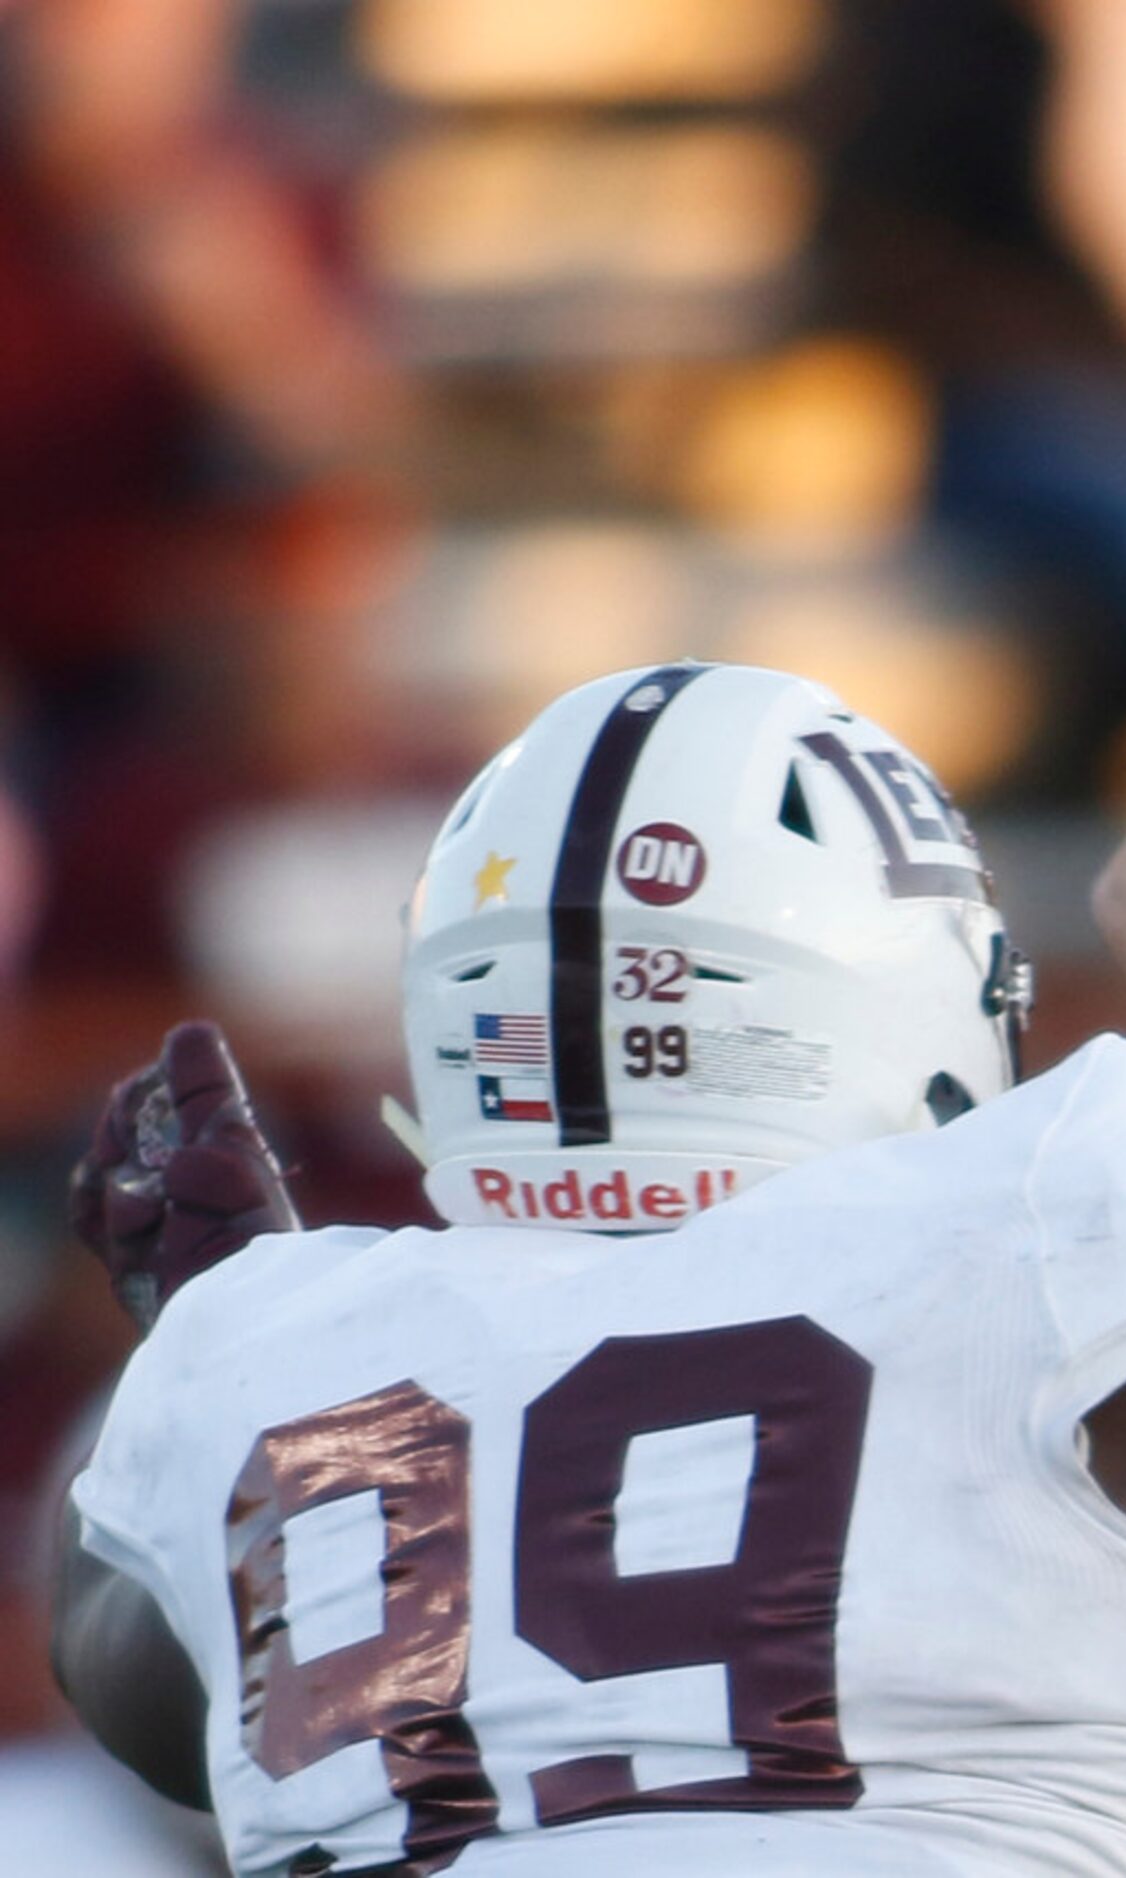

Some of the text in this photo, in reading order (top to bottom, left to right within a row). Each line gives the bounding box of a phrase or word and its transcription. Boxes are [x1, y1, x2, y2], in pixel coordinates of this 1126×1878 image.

[623, 834, 699, 888] DN
[612, 946, 690, 1003] 32
[622, 1025, 689, 1079] 99
[225, 1313, 874, 1878] 99
